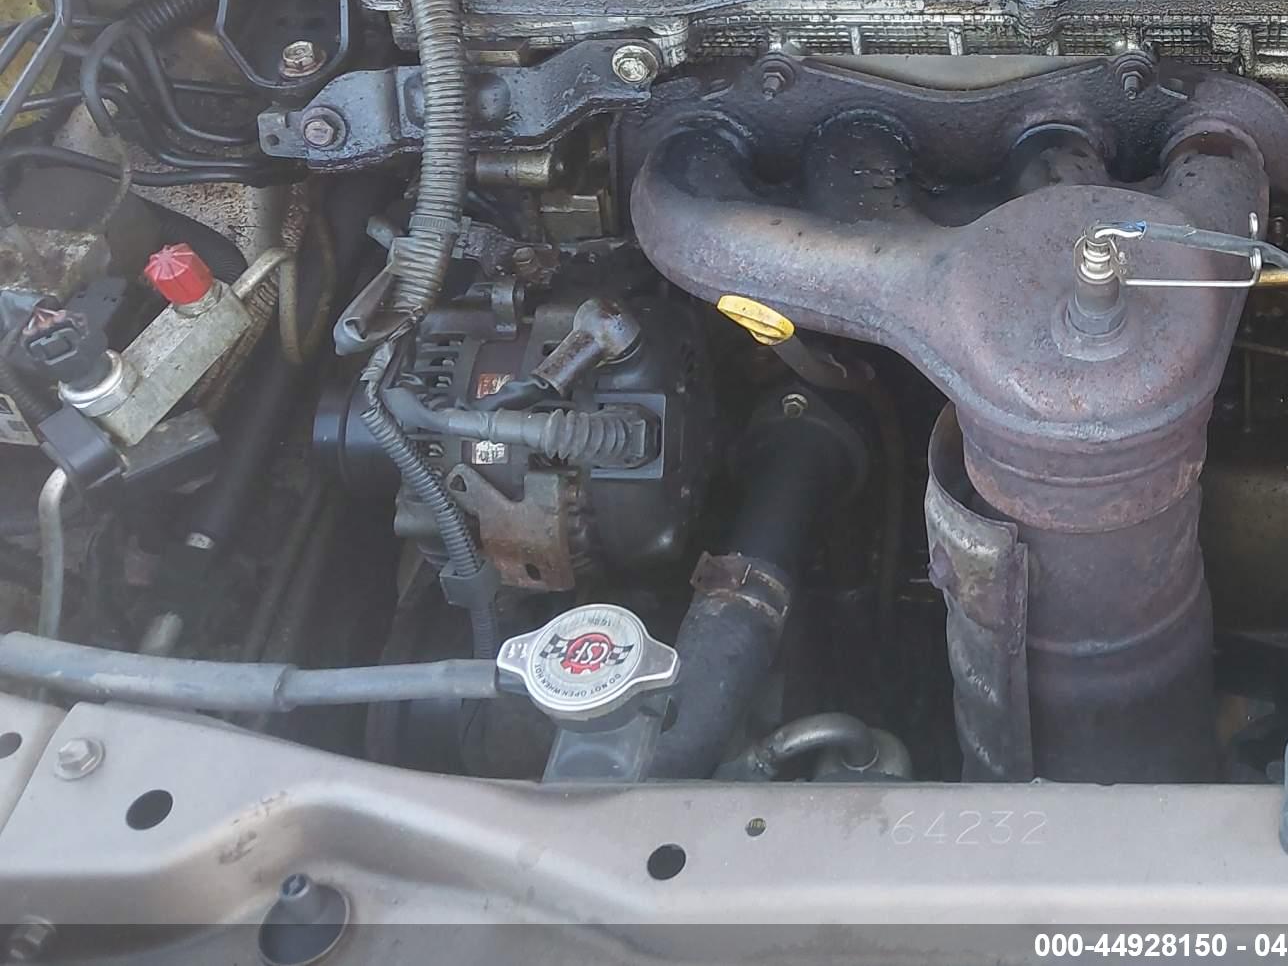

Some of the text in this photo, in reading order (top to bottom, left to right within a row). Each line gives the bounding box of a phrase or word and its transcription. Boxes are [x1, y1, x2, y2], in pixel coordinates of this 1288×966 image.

[571, 641, 609, 665] CSF
[534, 663, 622, 698] DO NOT OPEN WHEN HOT
[890, 809, 1050, 846] 64232
